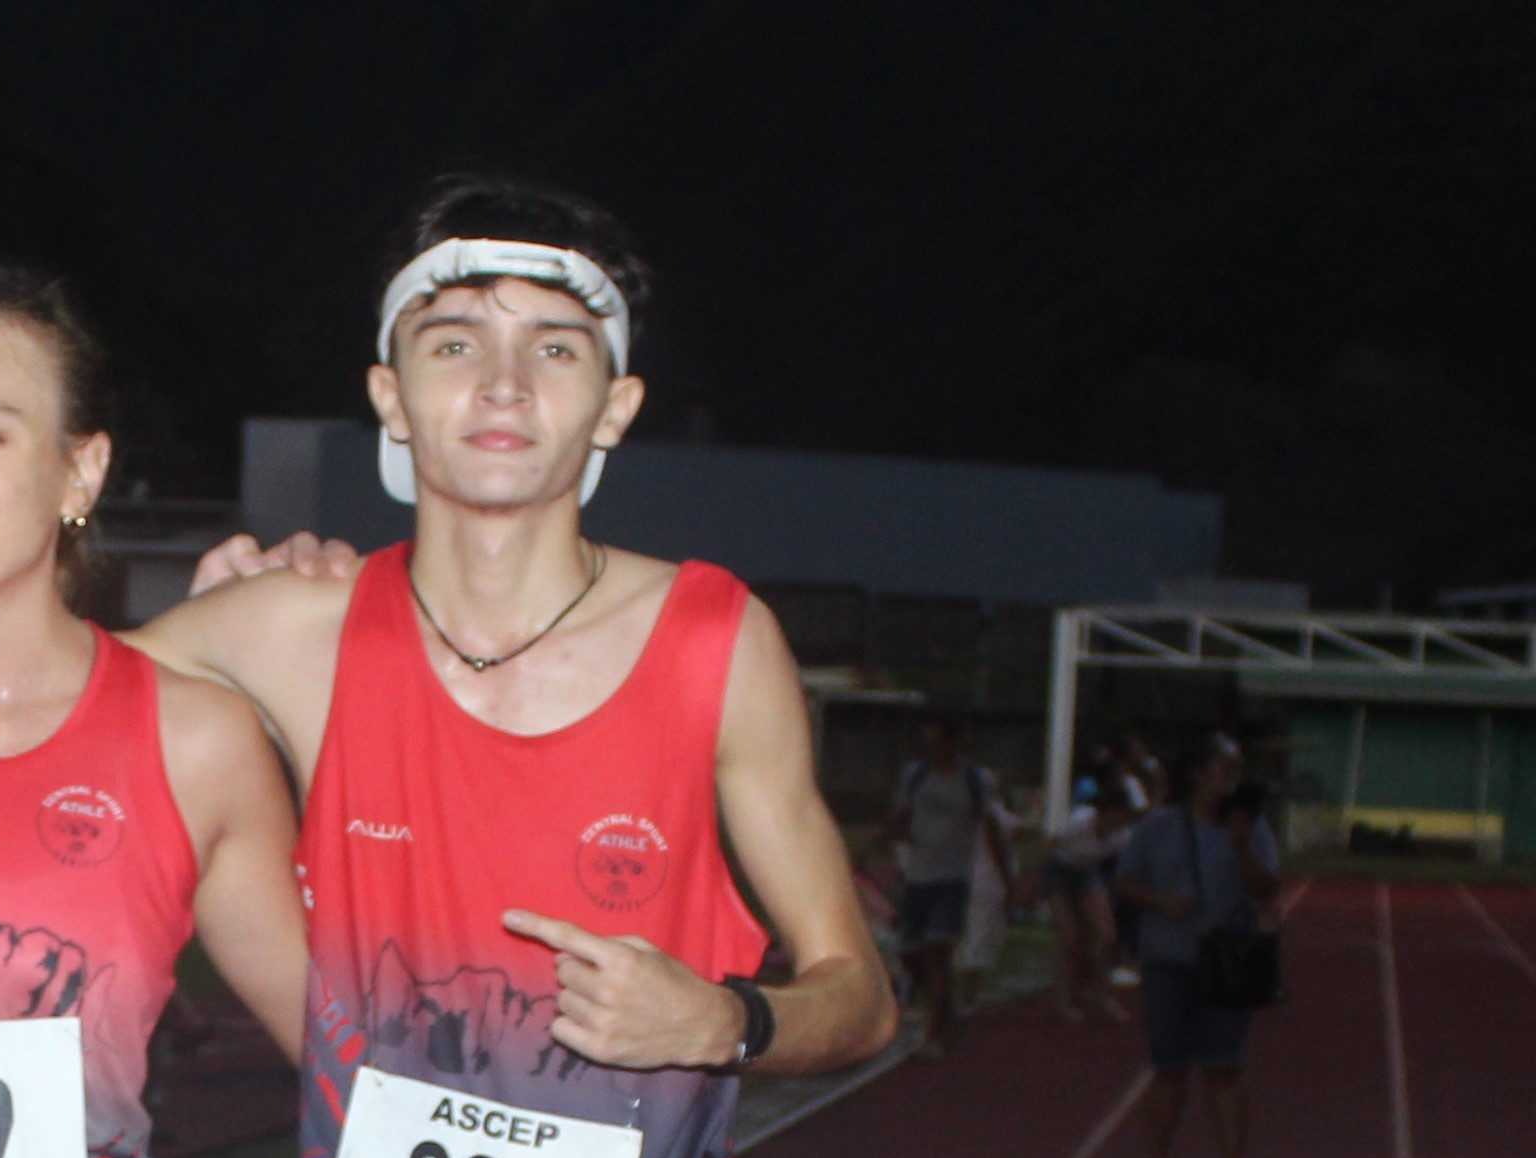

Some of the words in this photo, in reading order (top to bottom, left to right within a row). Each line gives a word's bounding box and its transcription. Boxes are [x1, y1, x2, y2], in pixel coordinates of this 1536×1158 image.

[59, 801, 105, 818] ATHLE
[580, 813, 633, 843] CENTRAL
[638, 818, 668, 851] SPORT
[598, 834, 648, 852] ATHLE
[430, 1097, 560, 1149] ASCEP
